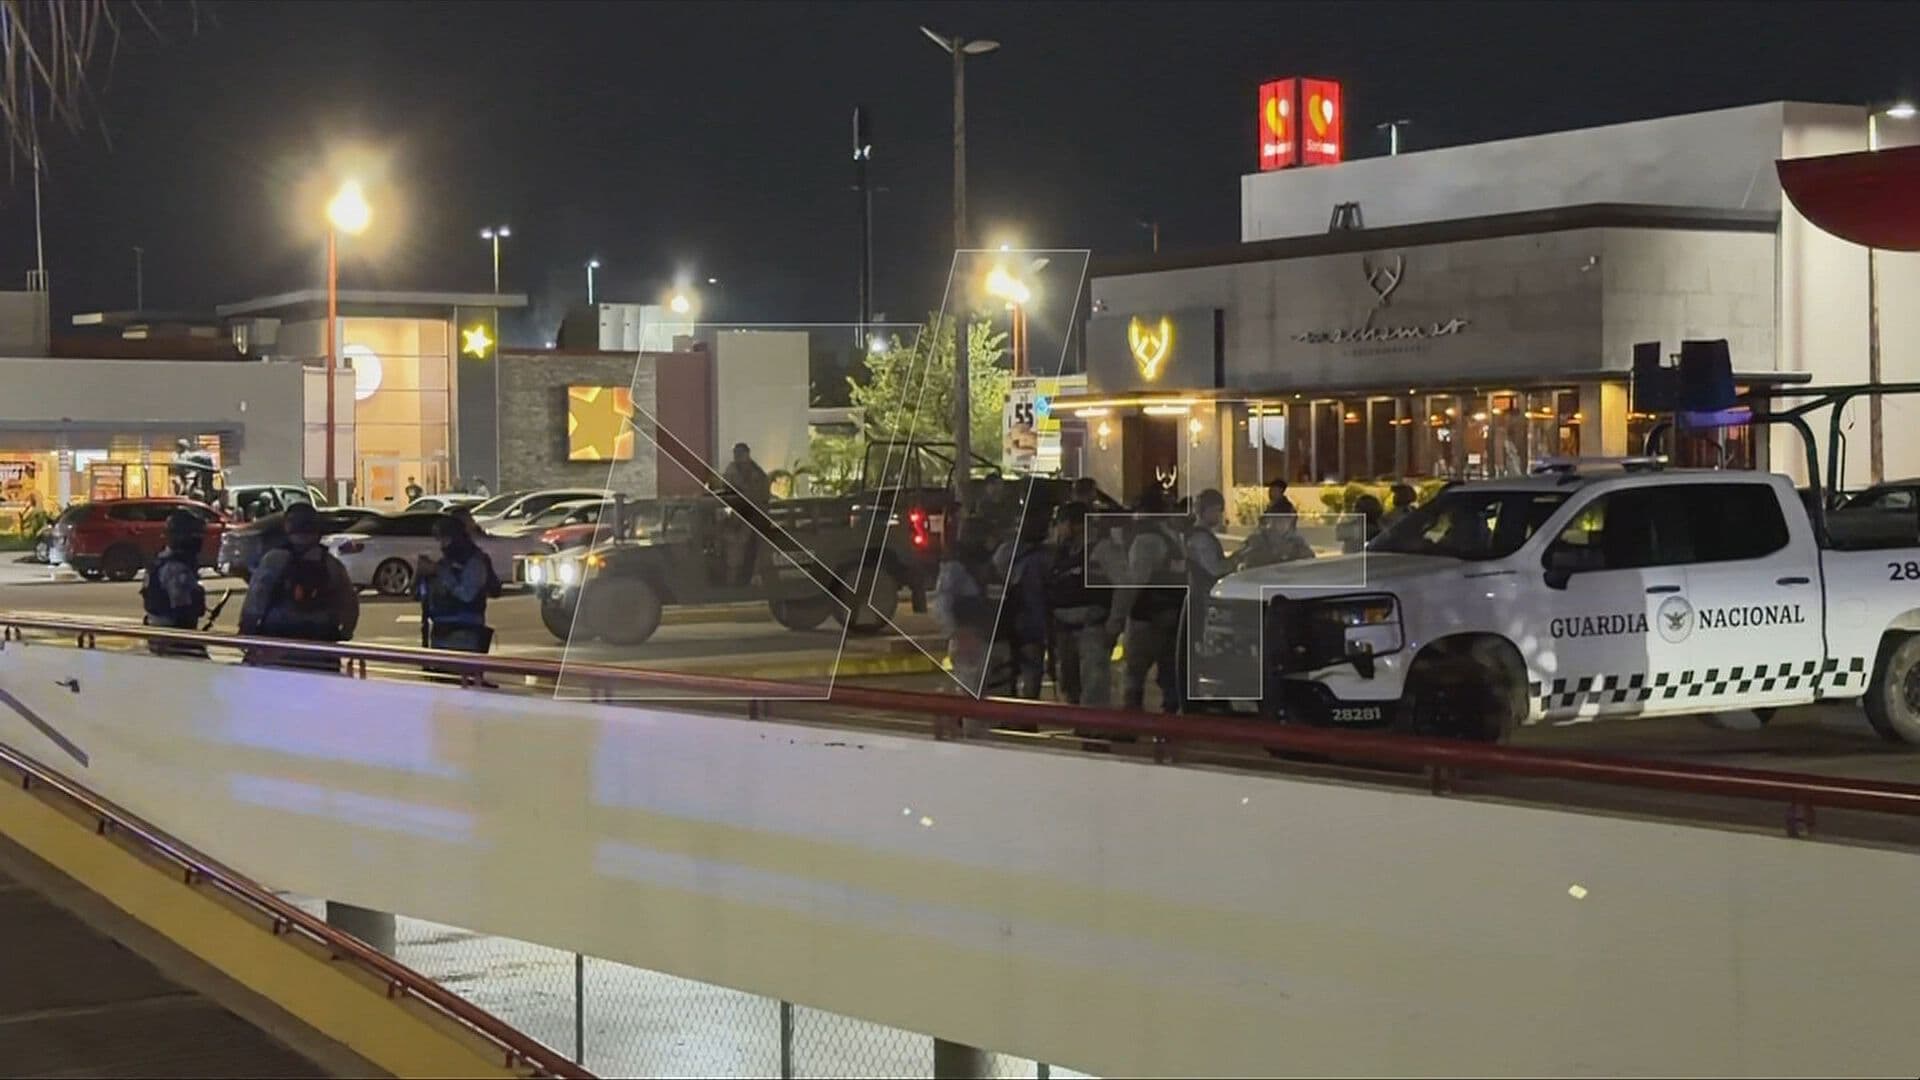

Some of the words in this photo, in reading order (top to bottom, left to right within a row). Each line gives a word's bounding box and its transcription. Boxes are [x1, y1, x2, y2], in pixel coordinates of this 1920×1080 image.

[1550, 612, 1650, 638] GUARDIA
[1698, 604, 1805, 630] NACIONAL
[1332, 706, 1382, 721] 28281
